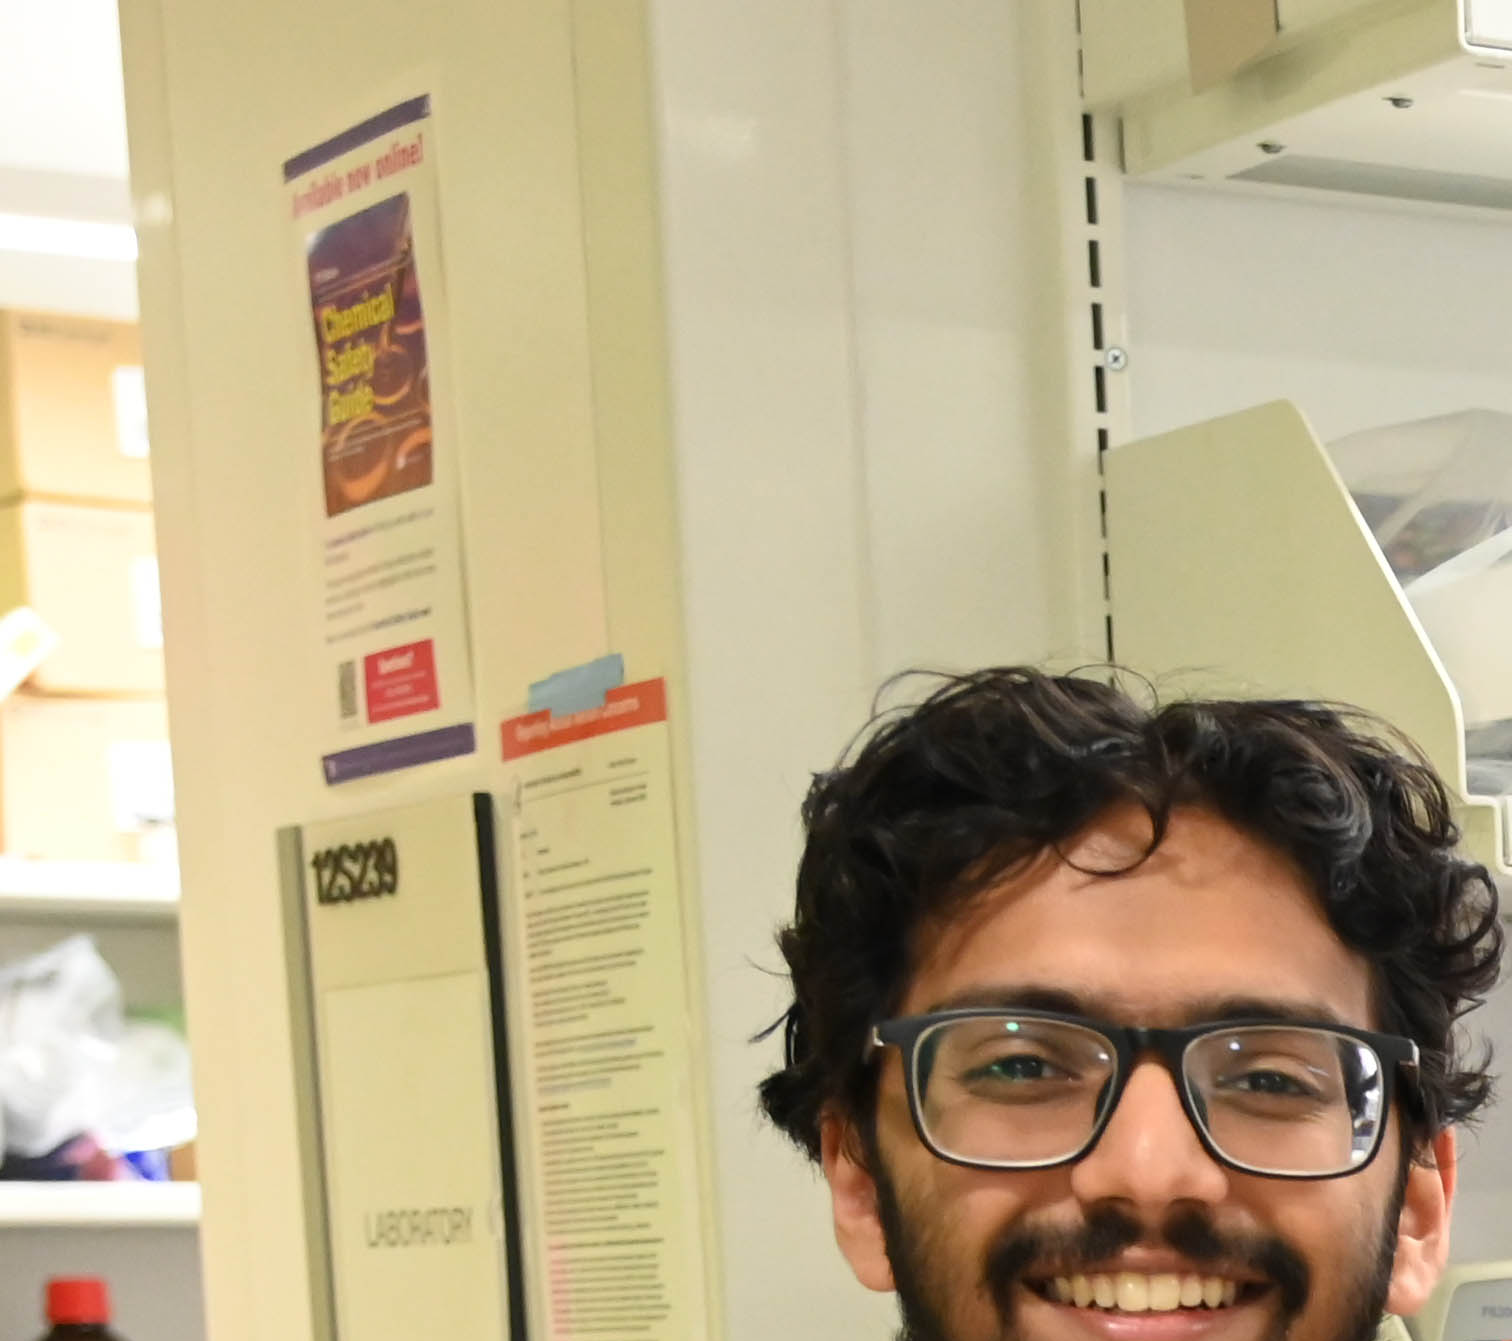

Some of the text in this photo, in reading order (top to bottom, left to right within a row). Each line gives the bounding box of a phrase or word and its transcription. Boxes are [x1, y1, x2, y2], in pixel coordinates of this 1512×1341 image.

[321, 281, 395, 343] Chemical
[326, 338, 376, 384] Safety
[366, 1207, 473, 1247] LABORATORY
